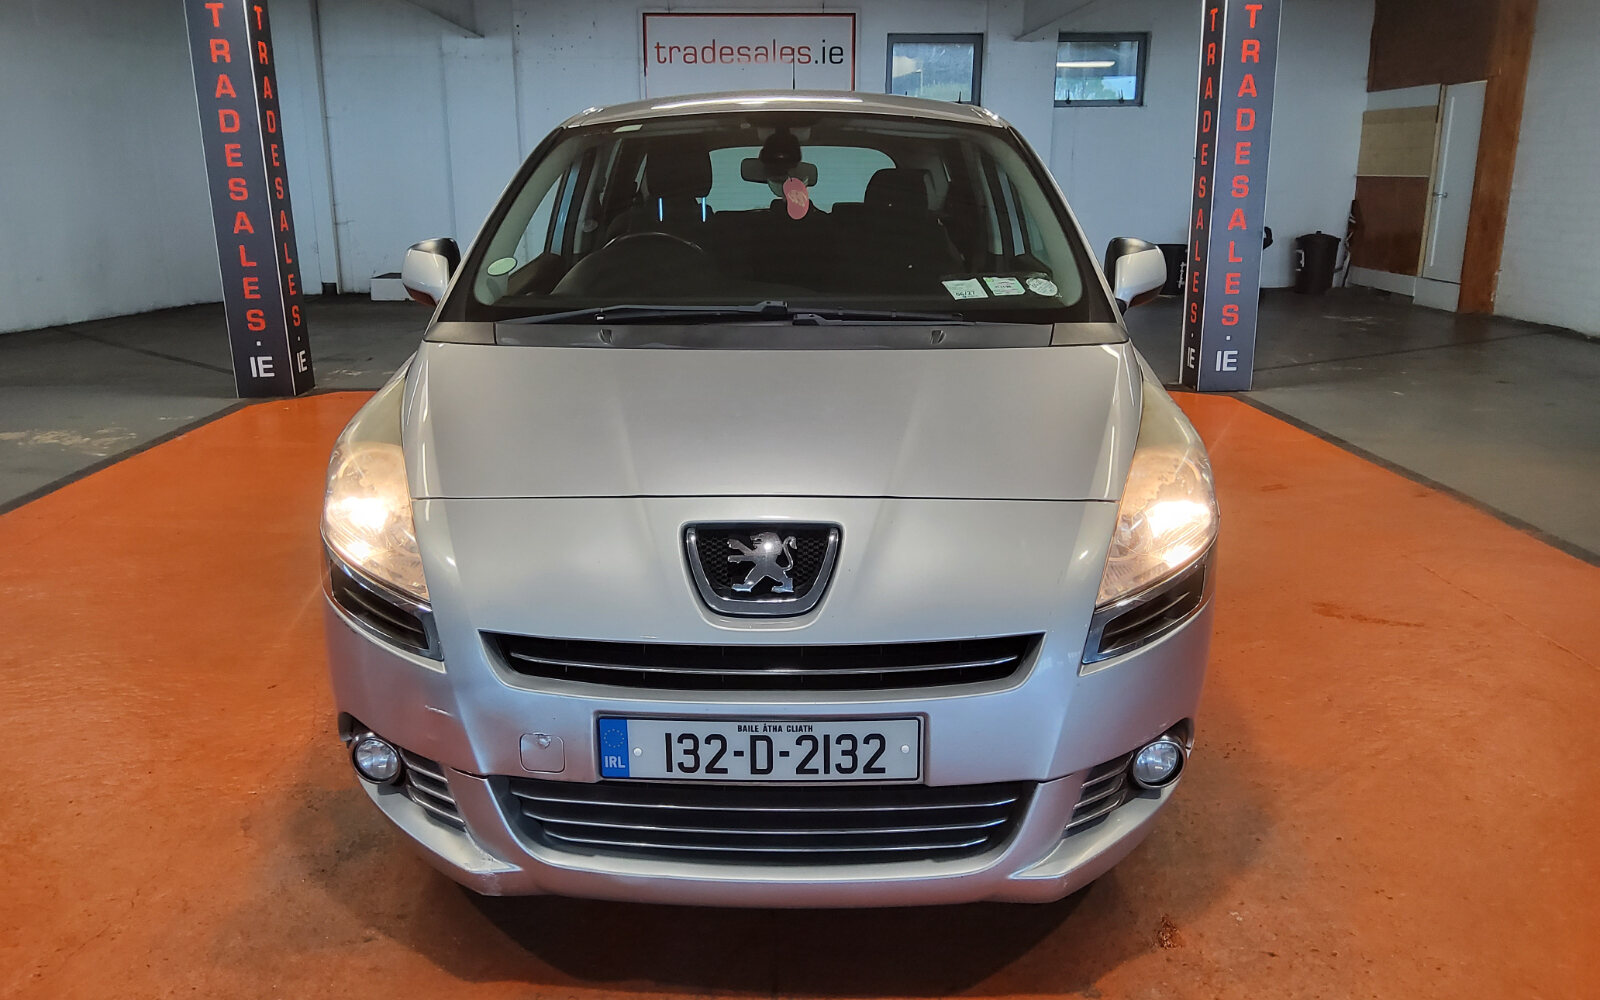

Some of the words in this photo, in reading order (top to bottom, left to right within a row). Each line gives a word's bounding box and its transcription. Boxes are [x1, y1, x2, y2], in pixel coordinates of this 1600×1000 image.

[654, 38, 844, 65] tradesales.ie
[737, 724, 759, 733] BAILE
[763, 723, 783, 733] ÁTHA
[786, 724, 813, 733] CLIATH
[604, 755, 626, 769] IRL
[664, 732, 886, 775] 132-D-2132
